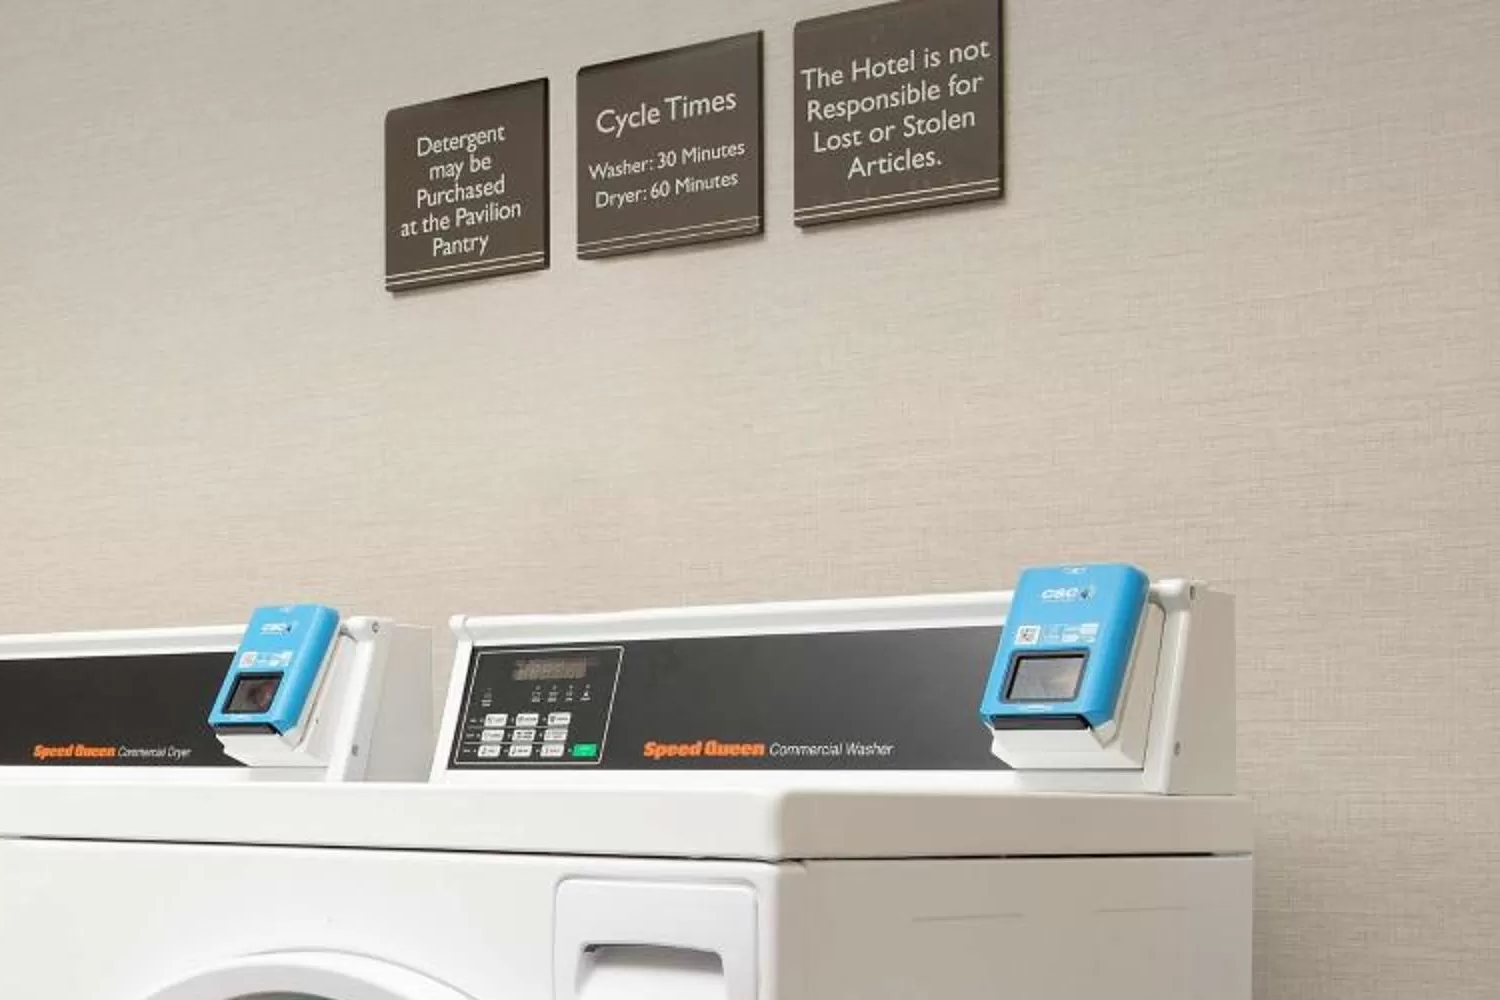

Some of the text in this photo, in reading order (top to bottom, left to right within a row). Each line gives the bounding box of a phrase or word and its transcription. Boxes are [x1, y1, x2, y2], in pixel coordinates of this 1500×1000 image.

[800, 41, 990, 91] The Hotel is not
[596, 92, 737, 138] Cycle Times
[807, 73, 984, 122] Responsible for
[417, 126, 506, 157] Detergent
[813, 109, 976, 153] Lost or Stolen
[429, 153, 493, 181] may be
[588, 143, 745, 180] Washer: 30 Minutes
[847, 147, 942, 180] Articles.
[417, 173, 506, 209] Purchased
[595, 173, 739, 209] Dryer: 60 Minutes
[400, 202, 521, 237] at the Pavilion
[433, 235, 489, 257] Pantry
[34, 743, 75, 760] Speed
[74, 743, 117, 758] Queen
[117, 745, 166, 758] Commercial
[643, 740, 895, 760] Speed Queen Commercial Washer
